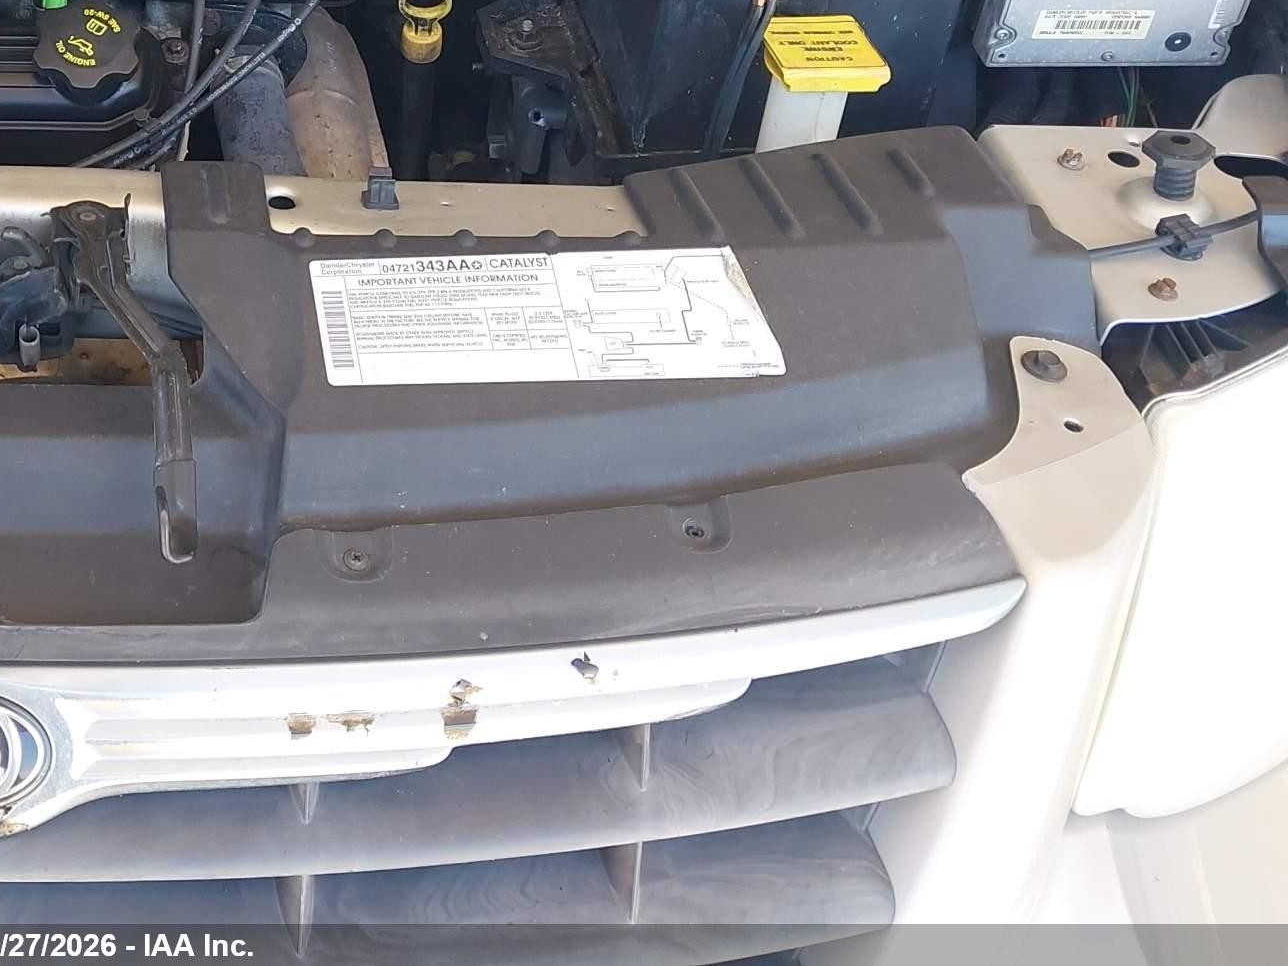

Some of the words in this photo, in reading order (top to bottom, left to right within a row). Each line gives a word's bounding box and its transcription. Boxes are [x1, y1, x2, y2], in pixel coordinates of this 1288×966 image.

[84, 9, 110, 21] 5W-20
[108, 19, 120, 32] SAE
[56, 40, 65, 53] OIL
[63, 52, 96, 66] ENGINE
[489, 258, 548, 269] CATALYST
[358, 276, 418, 286] IMPORTANT
[420, 276, 461, 285] VEHICLE
[464, 274, 538, 283] INFORMATION
